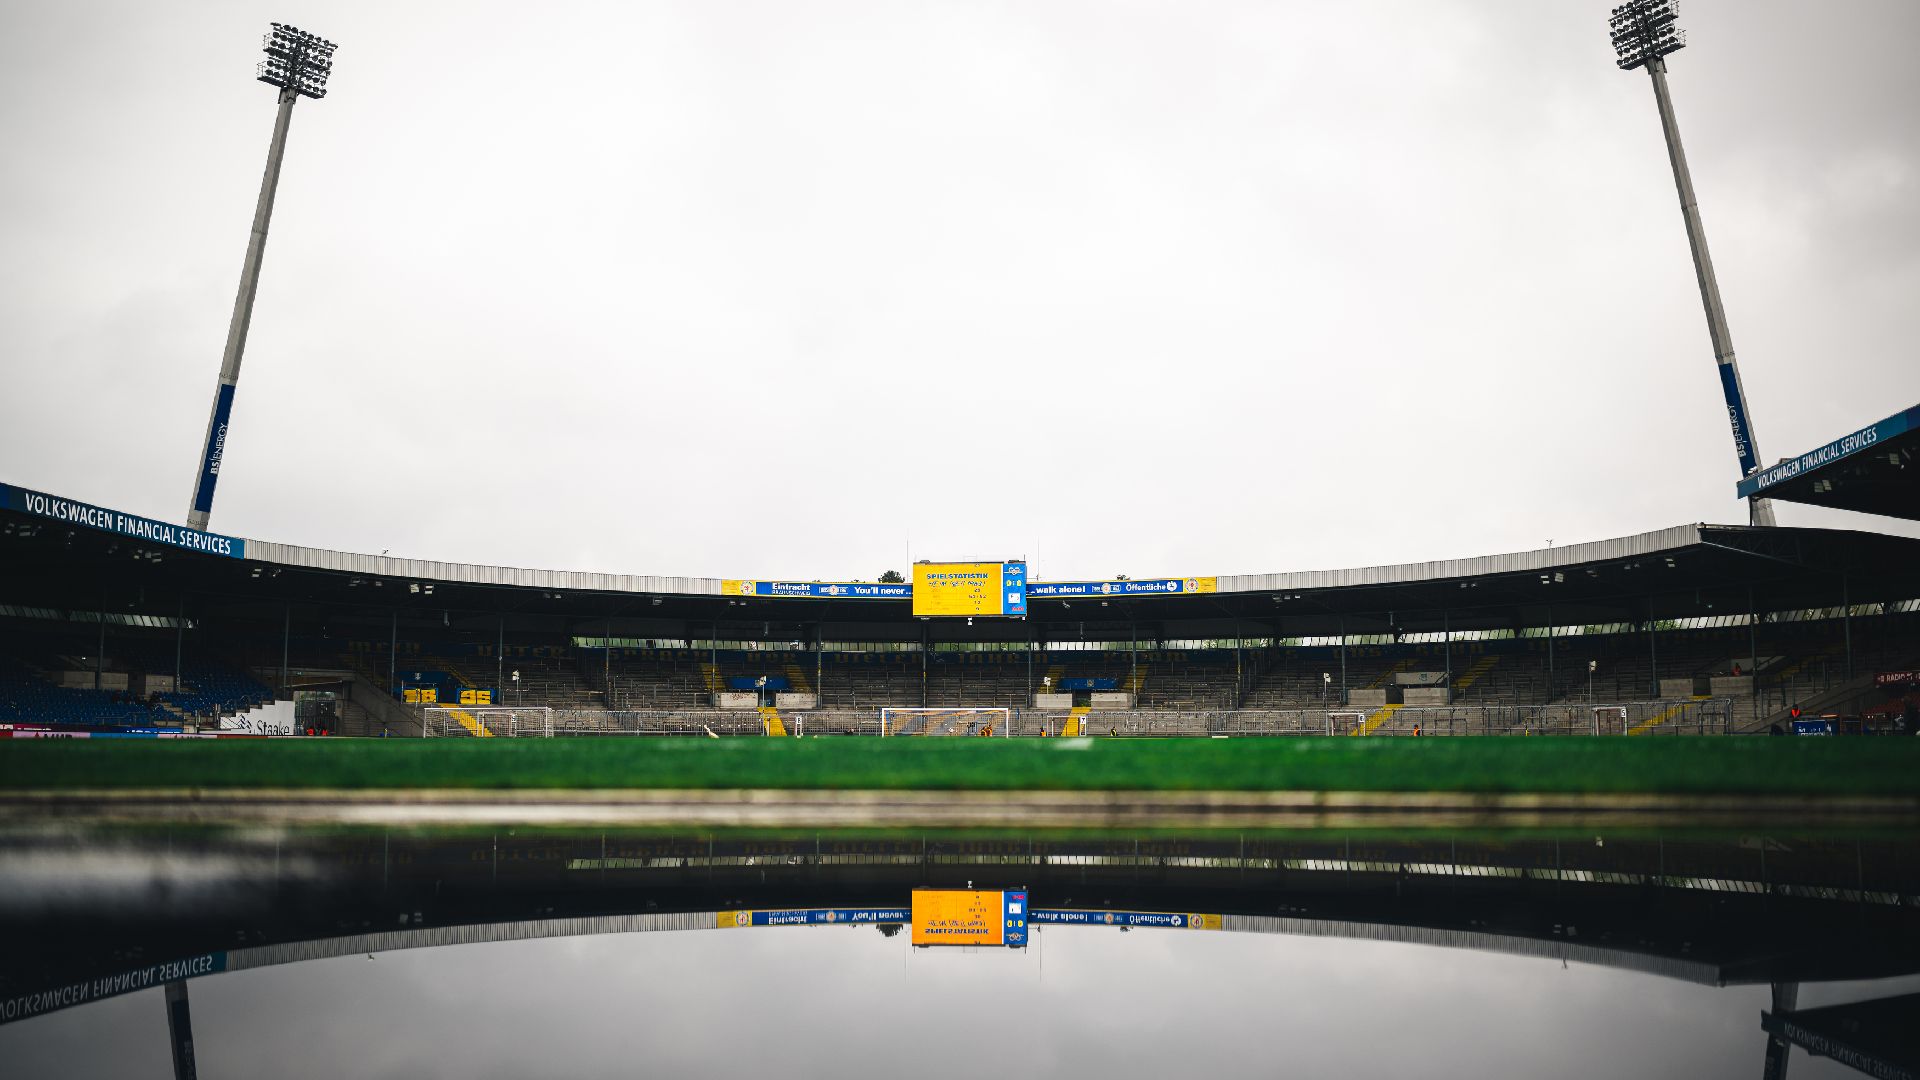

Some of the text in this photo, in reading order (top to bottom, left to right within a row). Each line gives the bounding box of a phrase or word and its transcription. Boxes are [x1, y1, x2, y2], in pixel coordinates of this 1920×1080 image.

[1757, 427, 1877, 489] VOLKSWAGEN FINANCIAL SERVICES
[25, 492, 231, 555] VOLKSWAGEN FINANCIAL SERVICES
[772, 583, 811, 591] Eintracht
[854, 586, 879, 595] You'll
[1058, 585, 1086, 593] alone!
[1126, 582, 1166, 592] Öffentliche
[403, 688, 437, 703] 18
[256, 719, 290, 736] Staake
